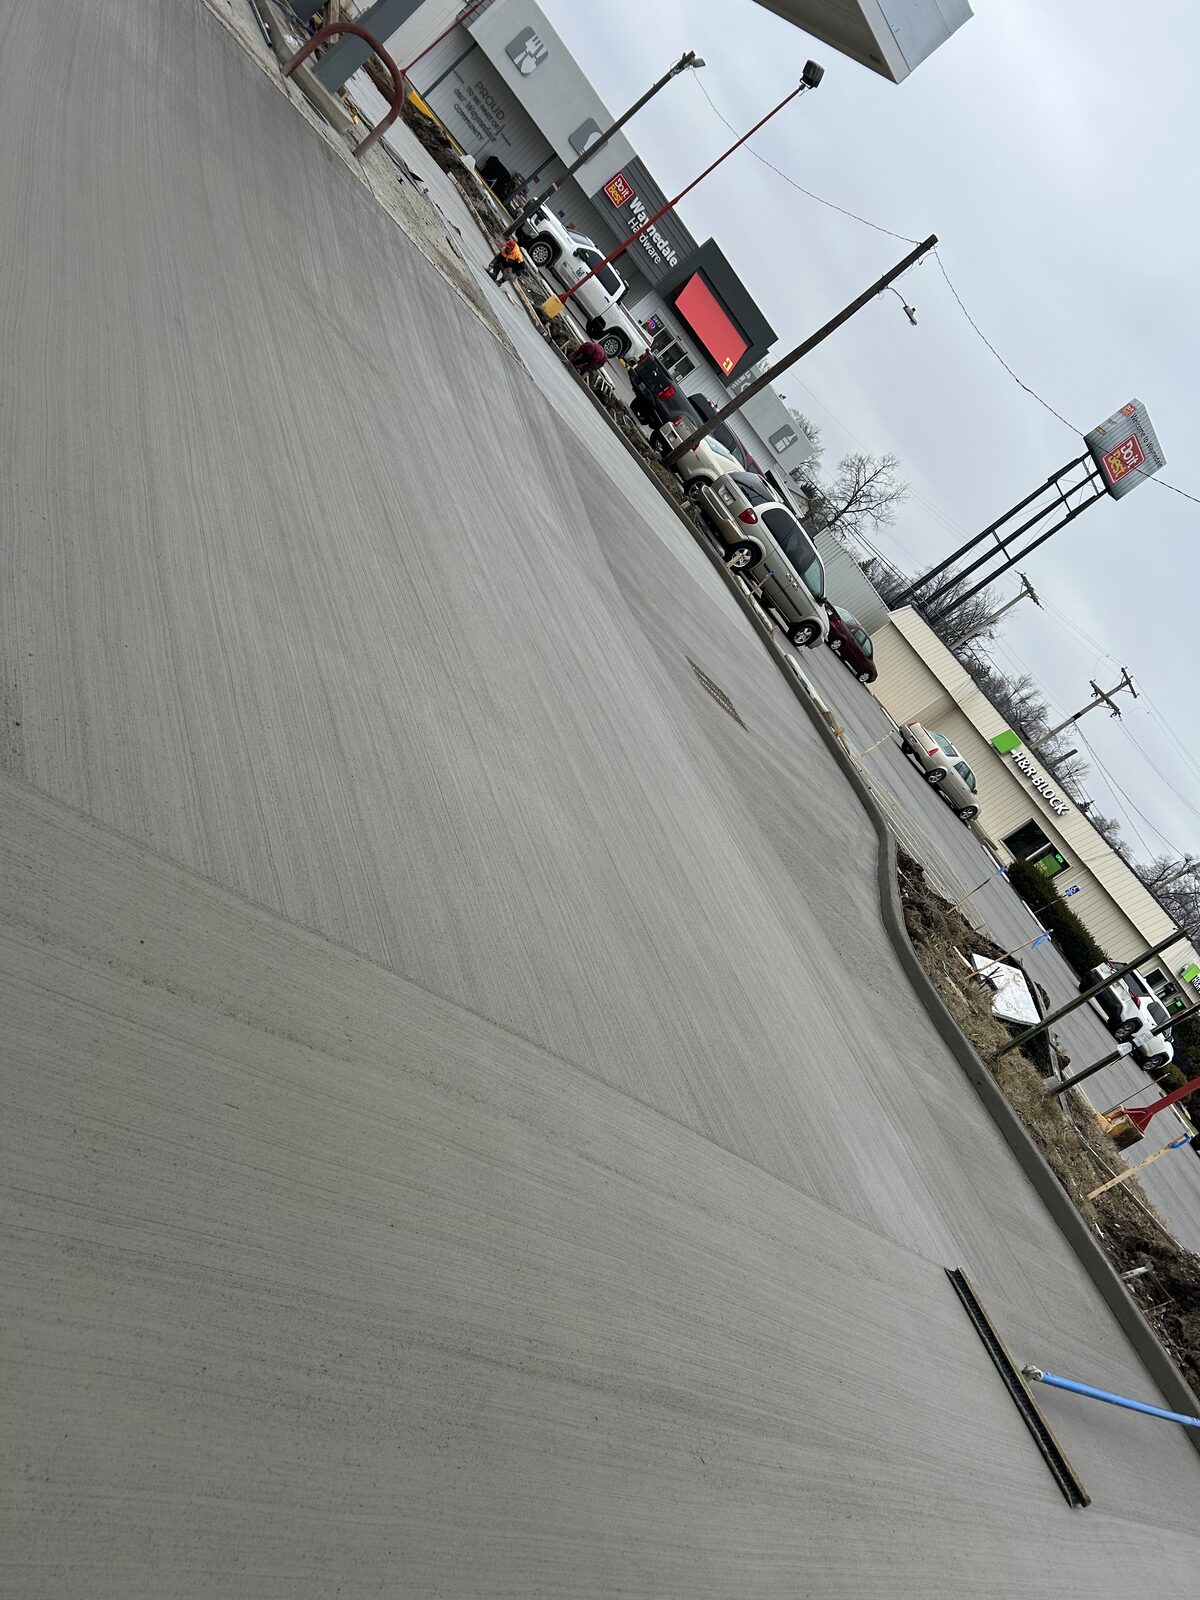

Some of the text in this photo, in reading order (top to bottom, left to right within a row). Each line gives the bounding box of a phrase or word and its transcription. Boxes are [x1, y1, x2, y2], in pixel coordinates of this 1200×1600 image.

[474, 81, 505, 120] PROUD
[453, 103, 484, 141] COMMUNITY
[607, 183, 624, 205] Best
[627, 217, 661, 264] Hadware
[1130, 412, 1146, 438] Welcome
[1146, 440, 1163, 468] Waynedale
[1108, 449, 1127, 478] Best
[1012, 751, 1069, 816] H&R BLOCK
